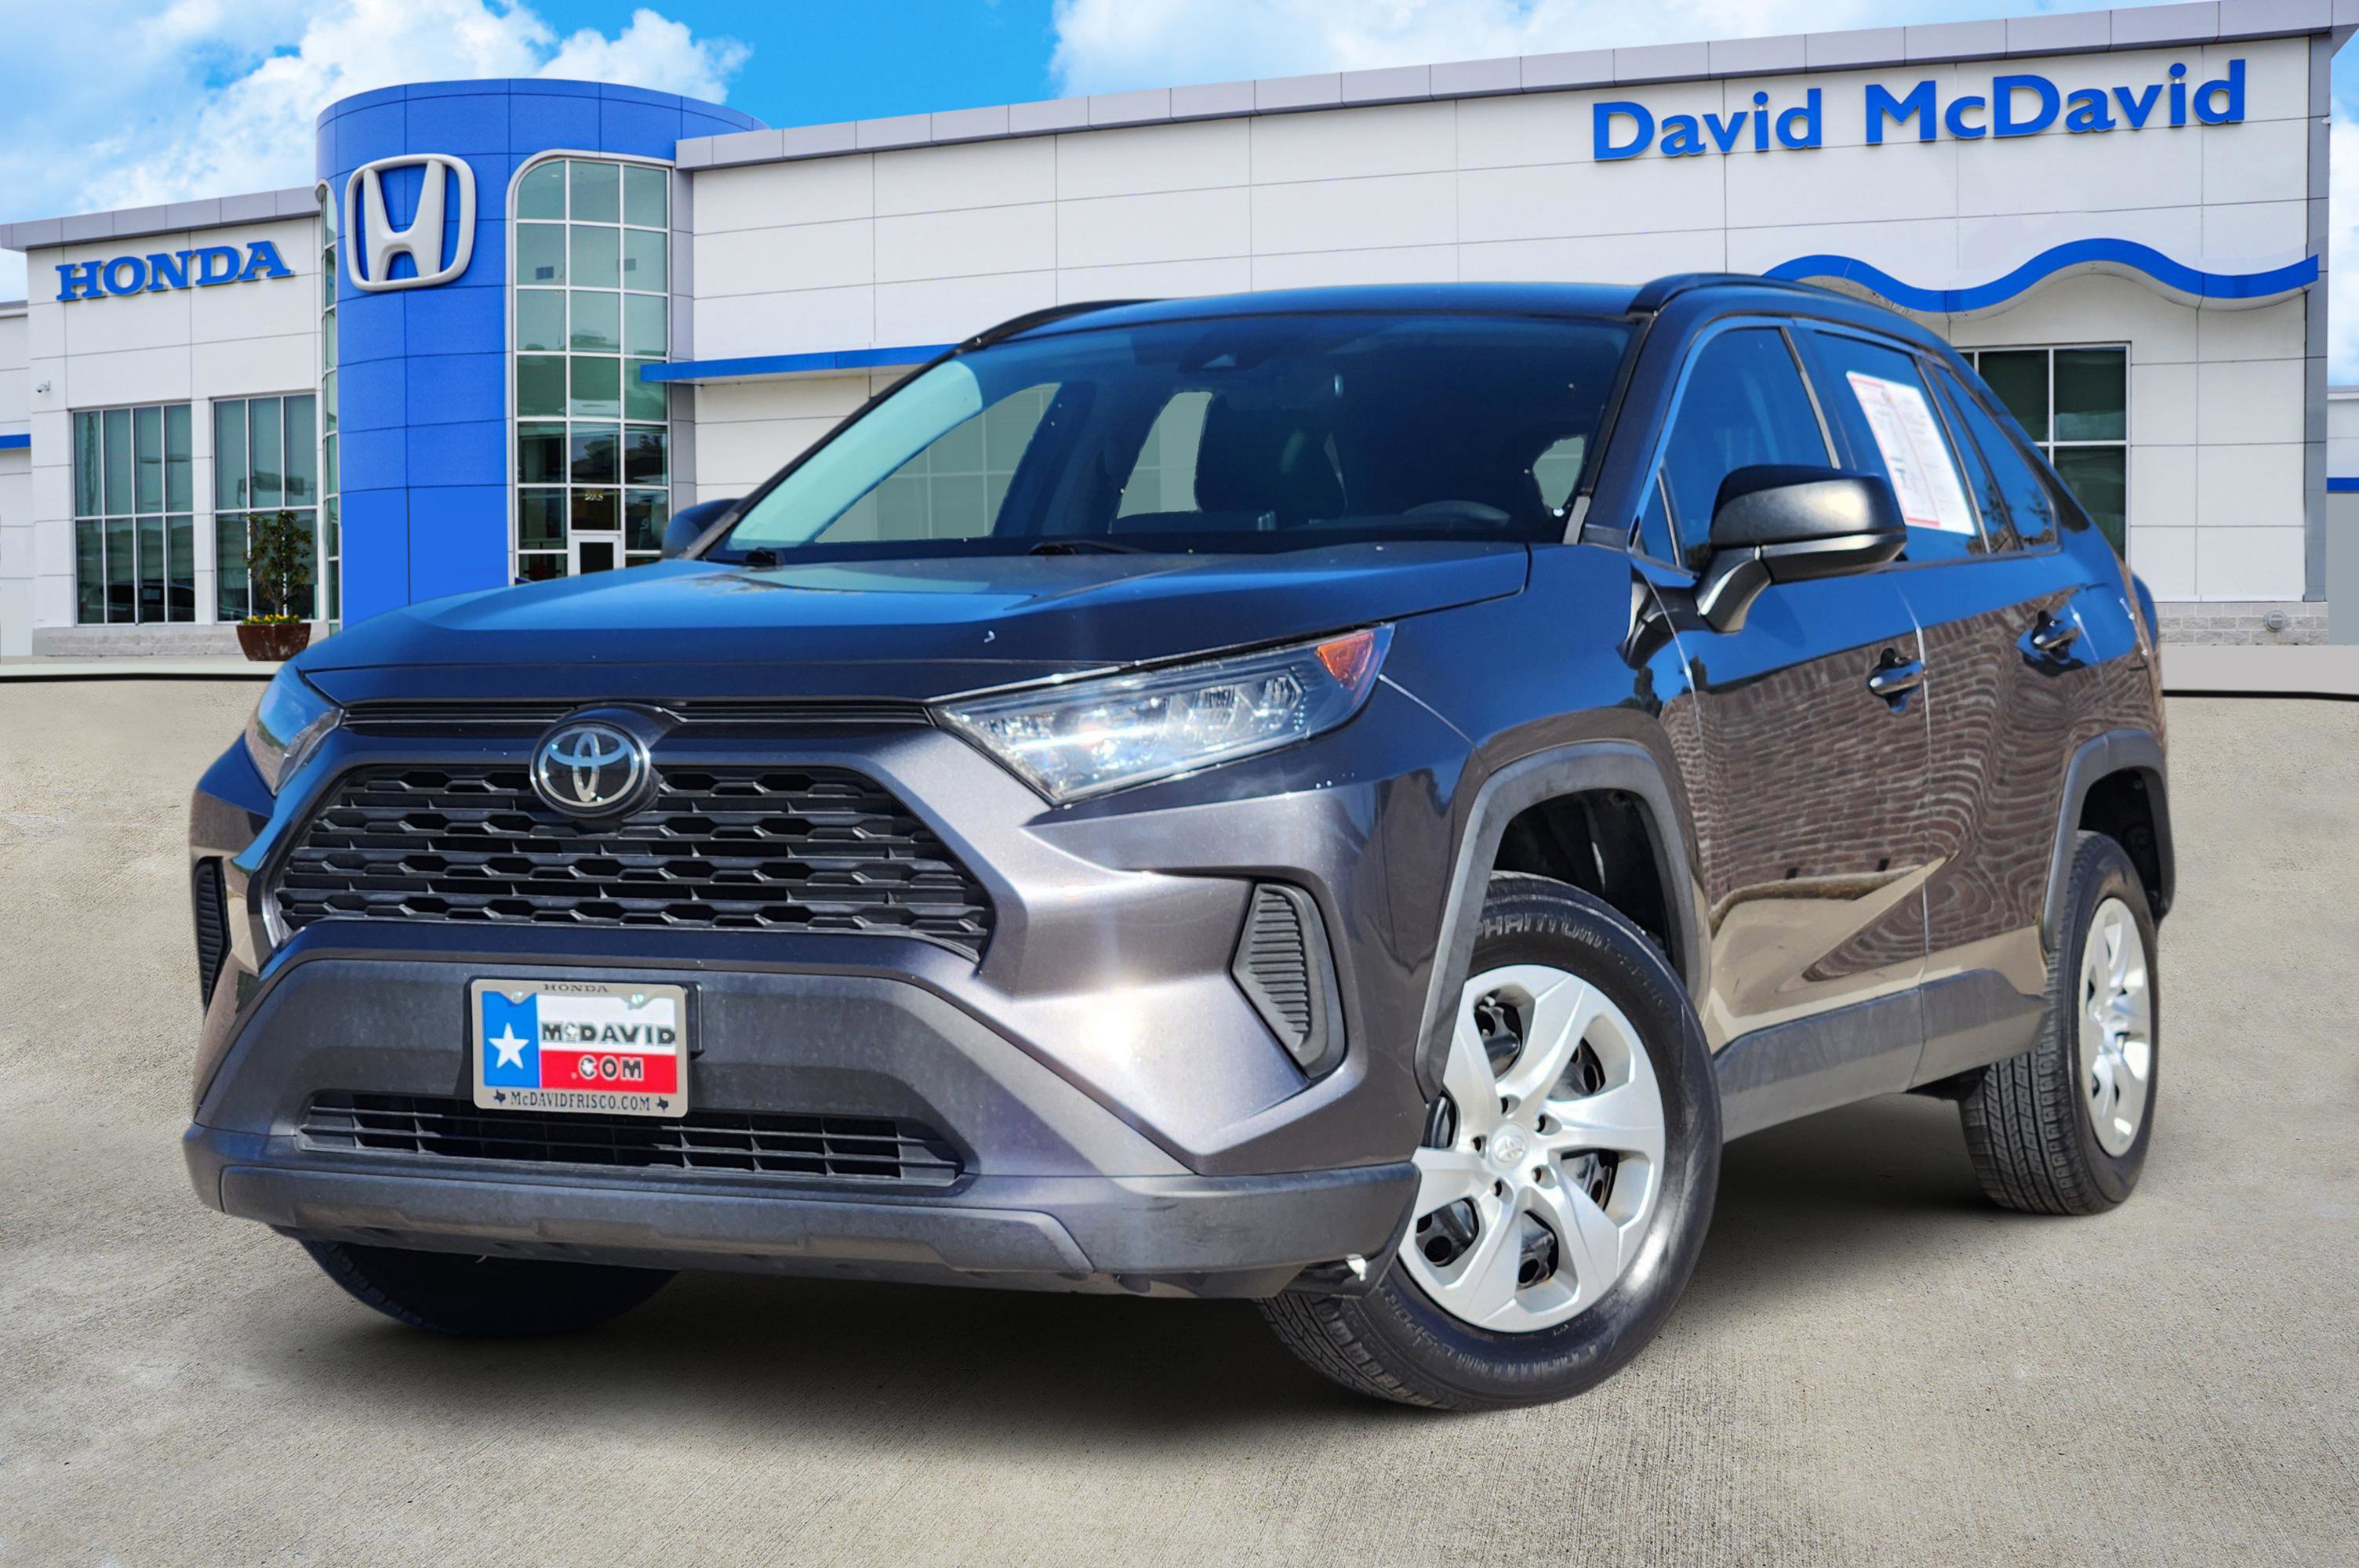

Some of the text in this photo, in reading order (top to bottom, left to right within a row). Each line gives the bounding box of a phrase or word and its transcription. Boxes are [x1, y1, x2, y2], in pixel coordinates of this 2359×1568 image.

[1594, 59, 2245, 161] David McDavid
[56, 240, 296, 302] HONDA
[543, 983, 609, 993] HONDA
[571, 1057, 643, 1081] .COM
[511, 1091, 650, 1112] McDAVIDFRISCO.COM
